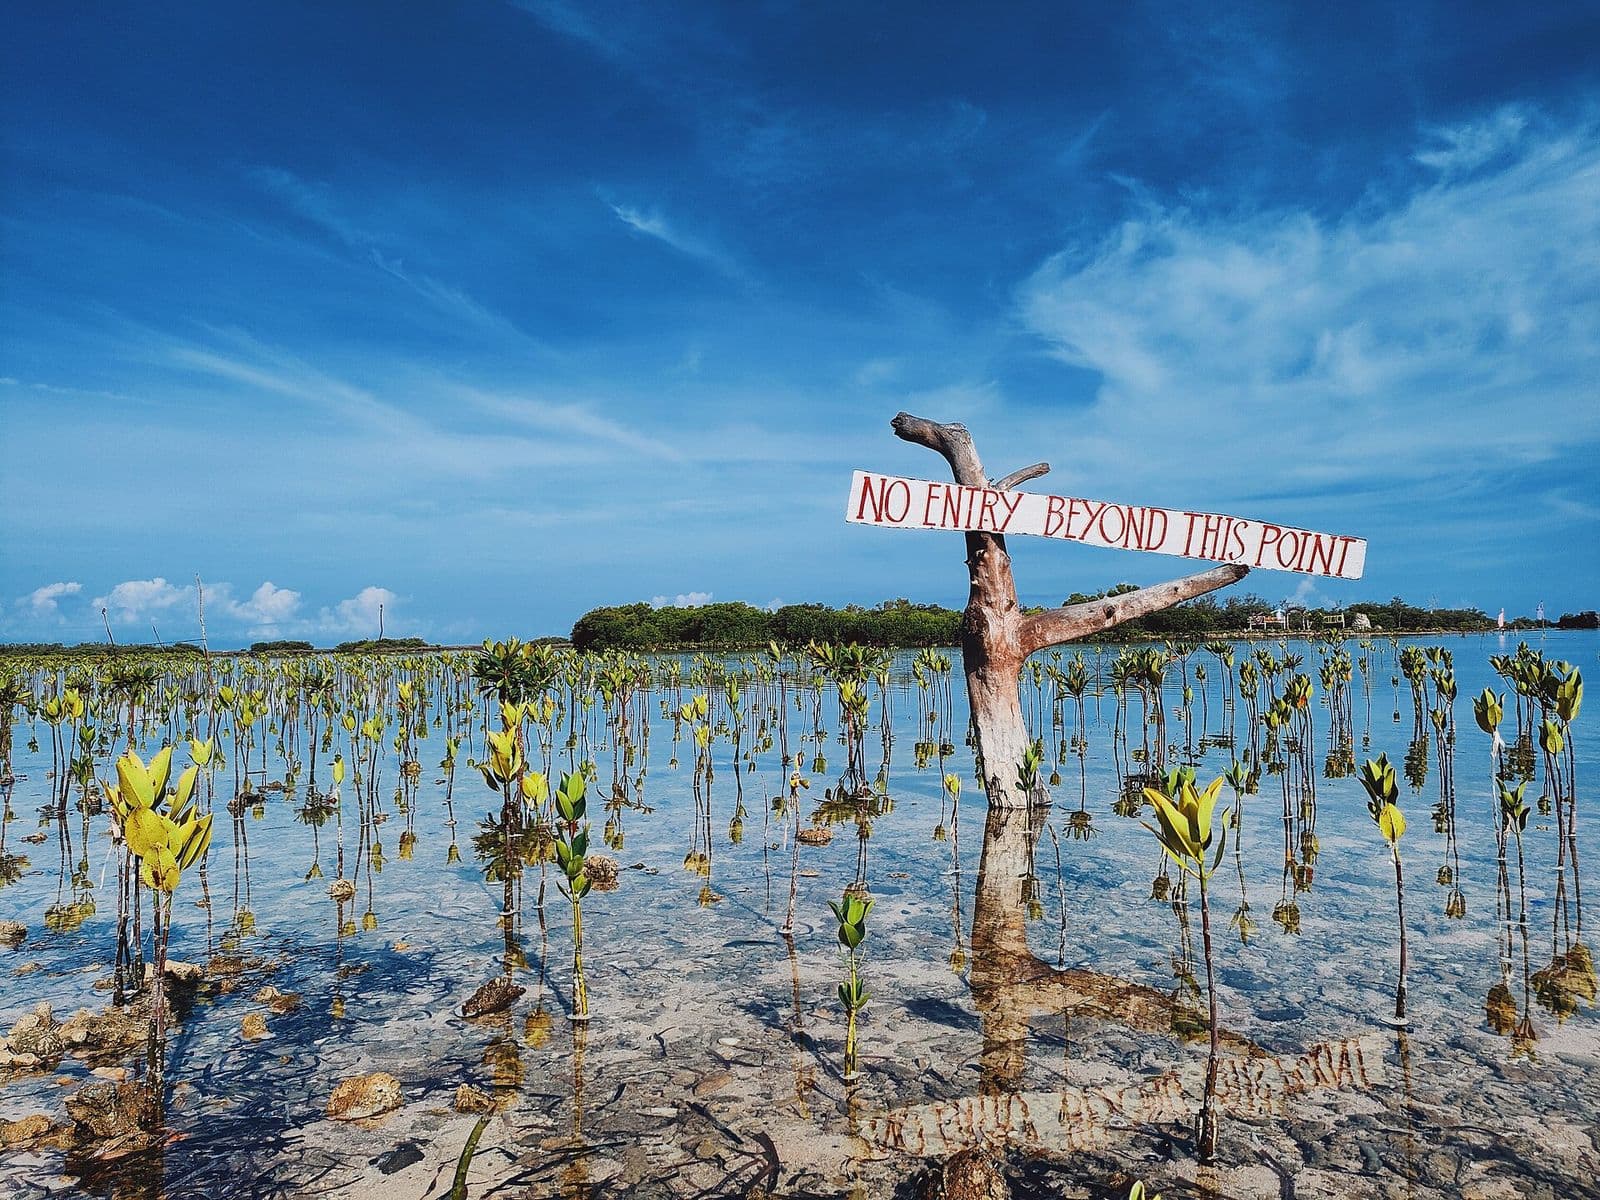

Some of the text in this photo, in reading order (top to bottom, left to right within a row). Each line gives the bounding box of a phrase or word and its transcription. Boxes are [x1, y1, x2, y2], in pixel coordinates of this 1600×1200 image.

[856, 476, 1358, 577] NO ENTRY BEYOND THIS POINT
